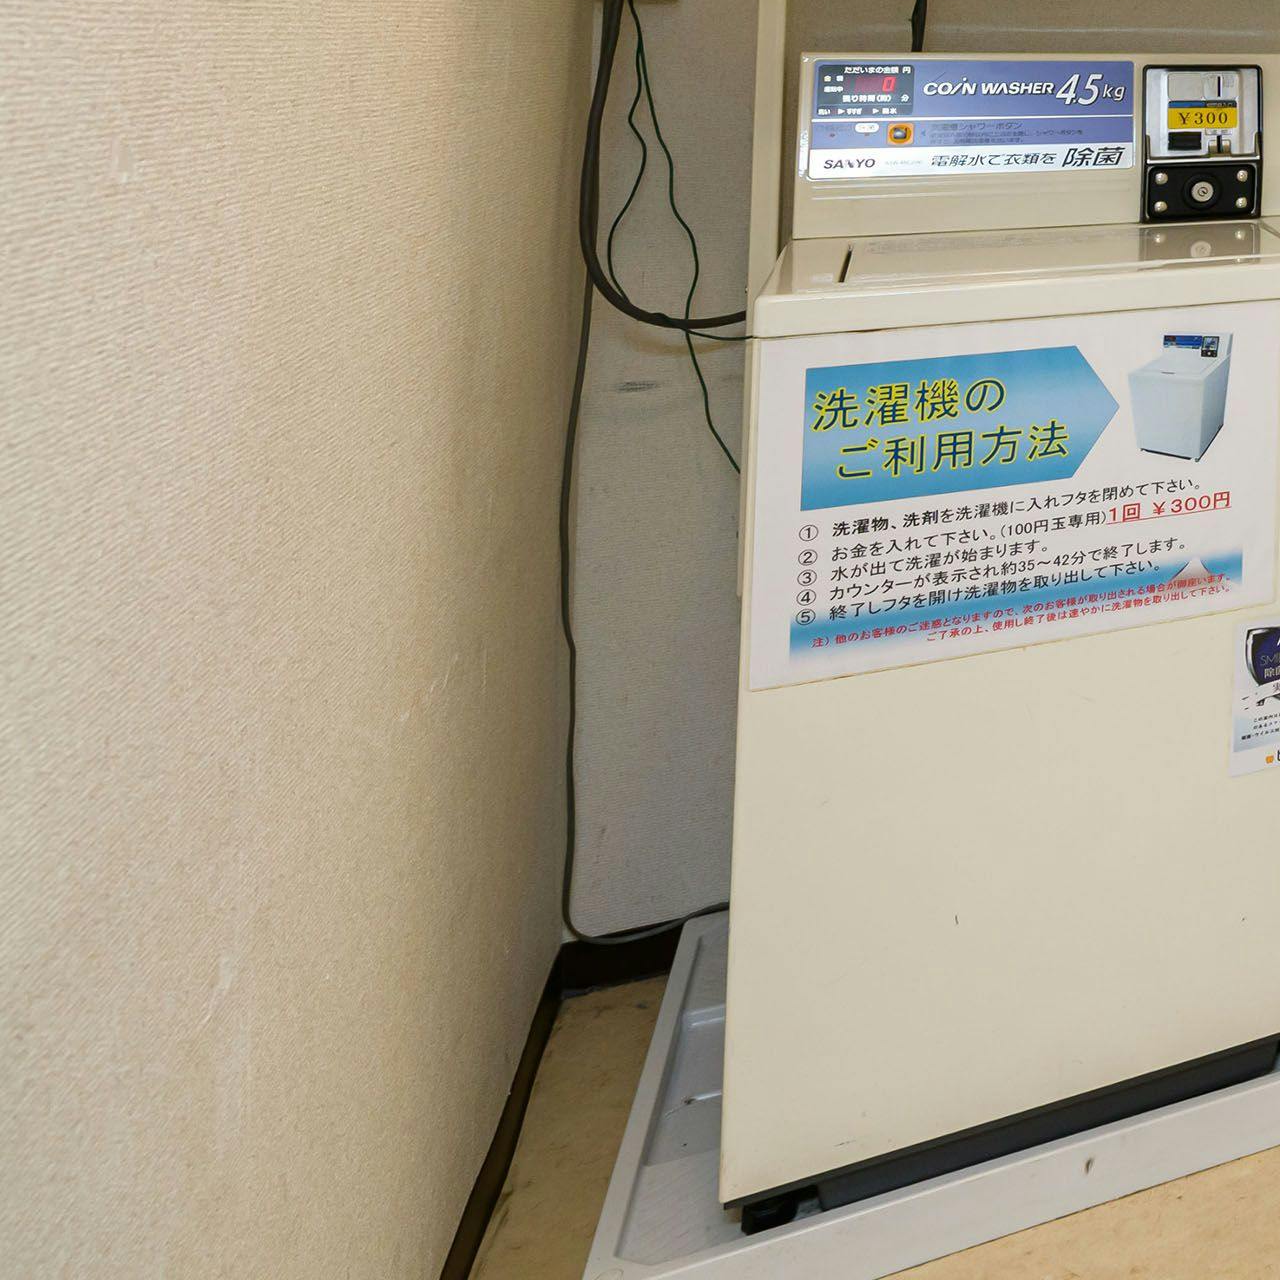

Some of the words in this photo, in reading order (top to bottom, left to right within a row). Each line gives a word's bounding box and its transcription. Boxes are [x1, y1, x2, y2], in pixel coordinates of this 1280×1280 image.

[902, 66, 911, 74] 円
[883, 77, 896, 91] 0
[982, 82, 1054, 95] WASHER
[824, 158, 875, 169] SANYO
[931, 152, 1056, 167] 電解水で衣類を
[1062, 147, 1125, 168] 除菌
[812, 378, 1006, 433] 洗濯機の
[837, 420, 1069, 479] ご利用方法
[798, 524, 819, 542] ①
[832, 476, 1201, 538] 洗濯物、洗剤を洗濯機に入れフタを閉めて下さい。
[796, 569, 817, 587] ③
[830, 541, 1049, 581] 水が出て洗濯が始まります。
[797, 548, 818, 566] ②
[796, 608, 816, 625] ⑤
[828, 558, 1161, 622] 終了しフタを開け洗濯物を取り出して下さい。
[796, 588, 817, 605] ④
[927, 587, 1232, 643] ご了承の上、使用し終了後は速やかに洗濯物を取り出して下さい。
